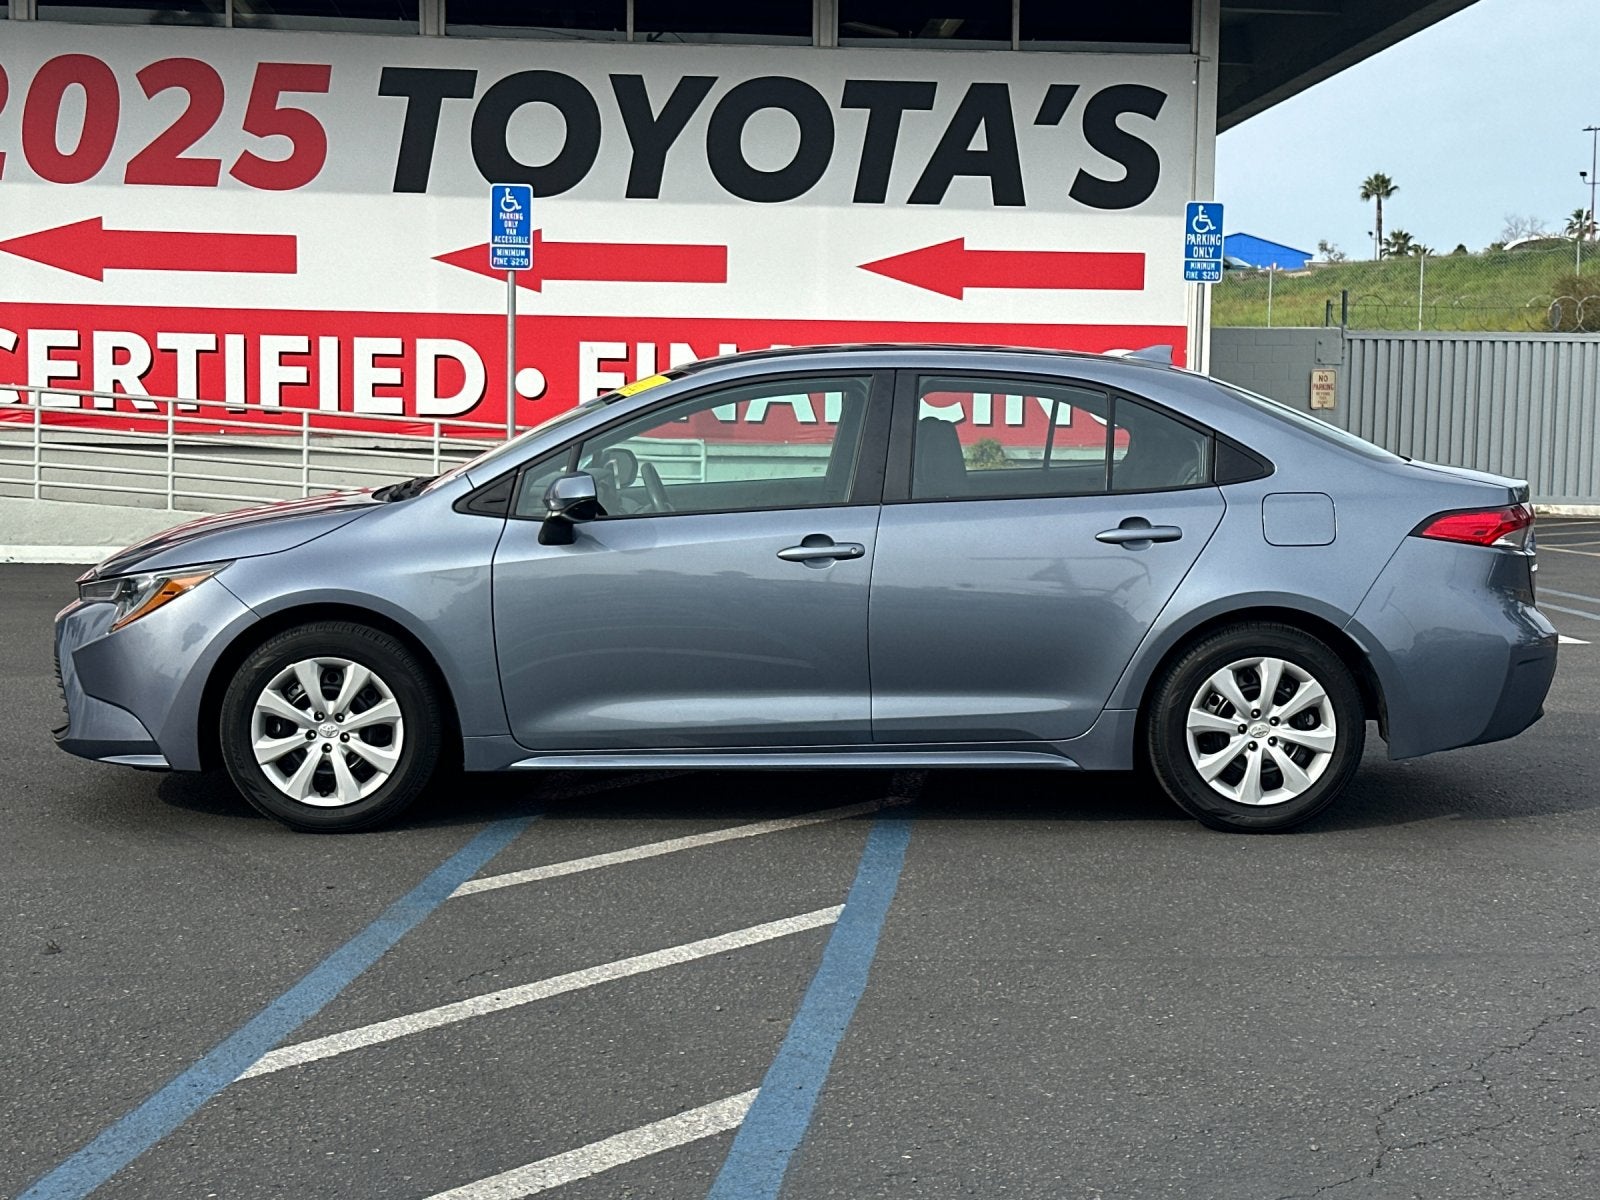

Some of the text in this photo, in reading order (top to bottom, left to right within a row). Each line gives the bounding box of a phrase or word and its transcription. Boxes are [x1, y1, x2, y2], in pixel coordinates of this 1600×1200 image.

[0, 54, 1169, 210] 025 TOYOTA'S
[499, 212, 524, 221] PARKING
[494, 235, 529, 244] ACCESSIBLE
[1186, 233, 1222, 246] PARKING
[496, 248, 526, 257] MINIMUM
[1193, 247, 1215, 258] ONLY
[493, 257, 529, 266] FINE $250
[1190, 262, 1216, 270] MINIMUM
[1185, 271, 1199, 279] FINE
[1318, 374, 1329, 382] NO
